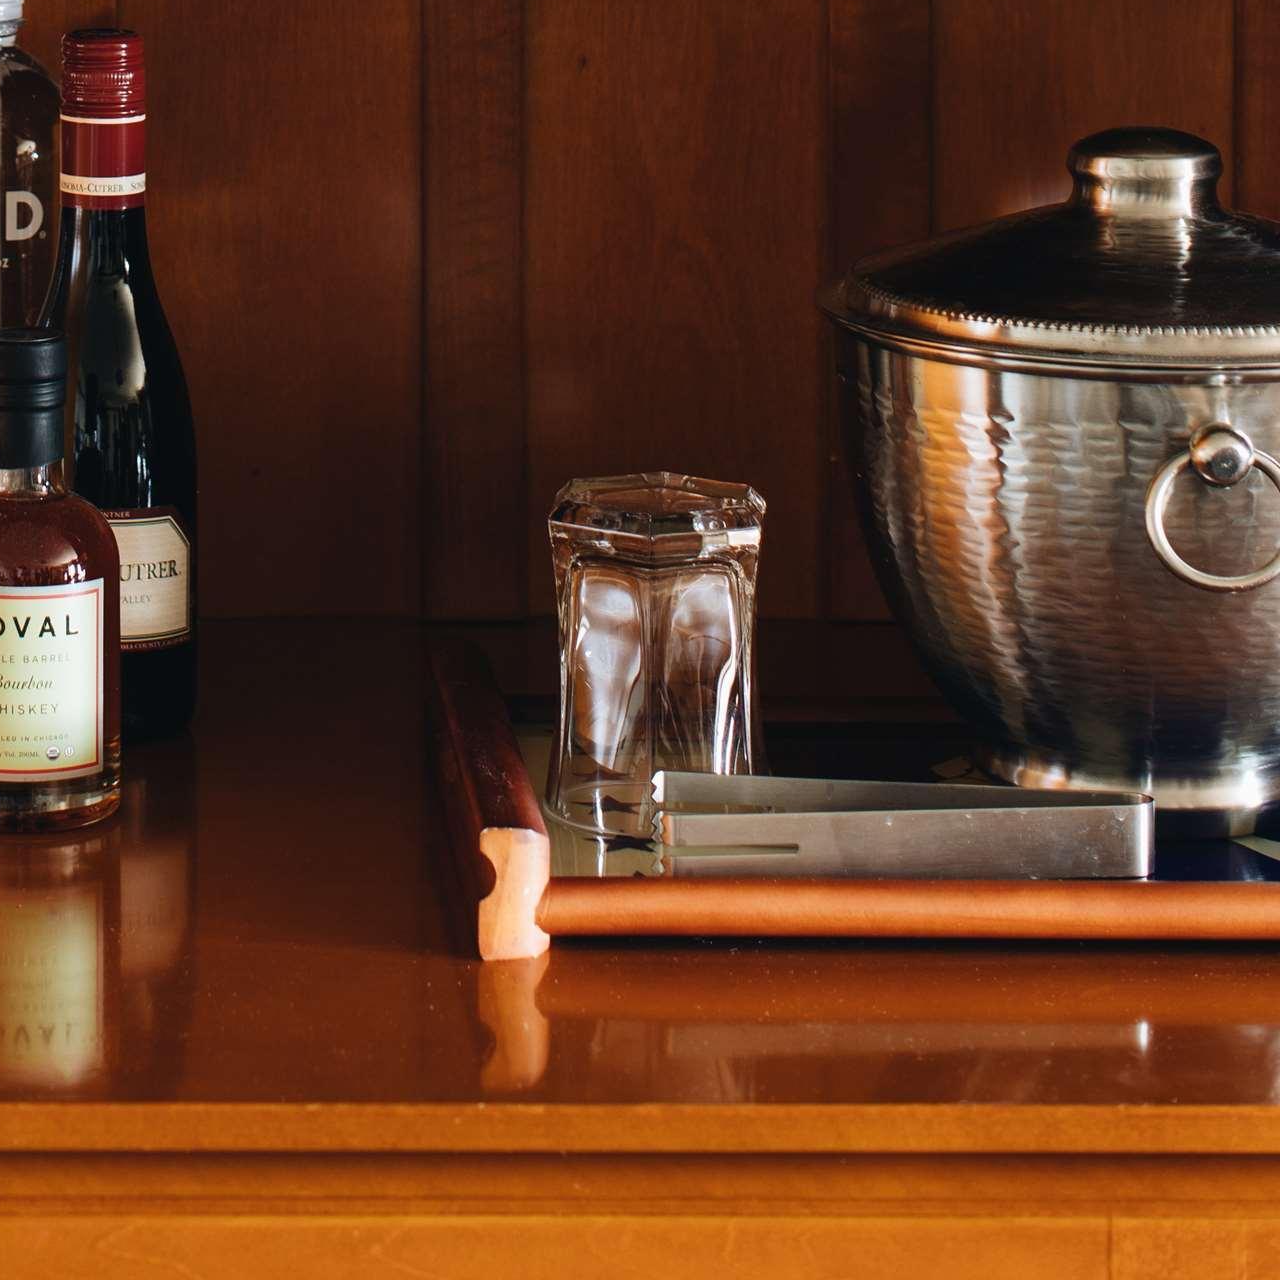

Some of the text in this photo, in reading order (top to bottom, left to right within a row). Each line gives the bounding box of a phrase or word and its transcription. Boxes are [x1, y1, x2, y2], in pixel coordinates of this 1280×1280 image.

[120, 559, 183, 582] UTRER.
[120, 594, 152, 605] ALLEY
[23, 654, 72, 664] BARREL
[33, 734, 70, 742] CHICAGO
